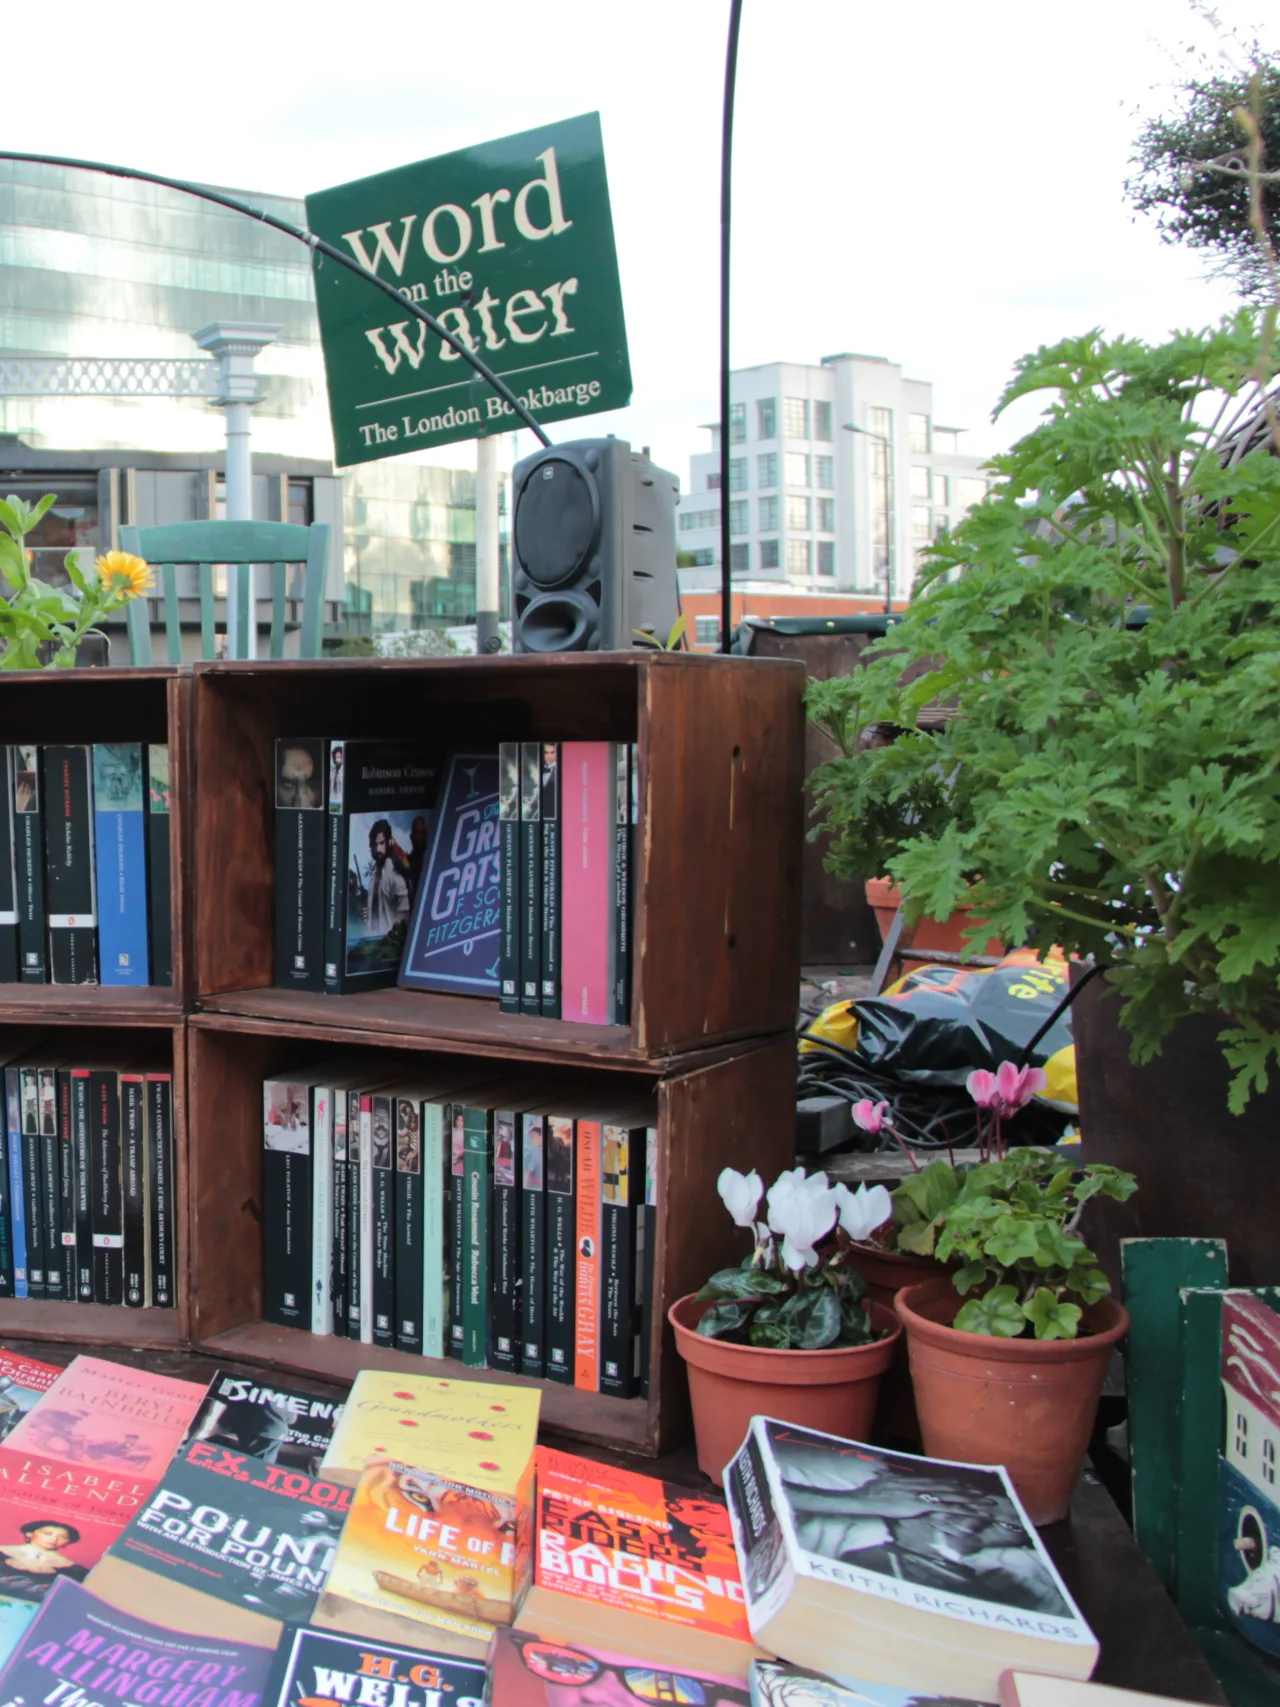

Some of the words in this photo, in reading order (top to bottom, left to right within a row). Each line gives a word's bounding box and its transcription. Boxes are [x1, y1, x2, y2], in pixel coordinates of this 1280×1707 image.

[341, 146, 574, 278] word
[397, 281, 429, 303] on
[432, 268, 474, 297] the
[365, 277, 580, 375] water
[360, 422, 398, 446] The
[403, 404, 481, 437] London
[485, 379, 602, 420] Bookbarge
[361, 765, 402, 780] Robinson
[403, 766, 436, 779] Crusoe
[426, 908, 500, 947] FITZGERA
[128, 1087, 136, 1107] MARK
[128, 1108, 136, 1130] TWAIN
[155, 1115, 164, 1155] CONNECTICUT
[78, 1120, 87, 1160] ADVENTURES
[129, 1145, 137, 1168] TRAMP
[79, 1170, 87, 1185] TOM
[129, 1168, 138, 1197] ABROAD
[156, 1156, 165, 1184] YANKEE
[471, 1171, 480, 1200] Cousin
[79, 1185, 88, 1211] SAWYER
[157, 1195, 165, 1212] KING
[471, 1201, 480, 1245] Rosamund
[158, 1242, 166, 1265] COURT
[471, 1249, 480, 1285] Rebecca
[471, 1285, 480, 1304] West
[577, 1304, 595, 1360] GRAY
[103, 1388, 178, 1414] BERYL
[287, 1429, 309, 1441] The
[21, 1460, 147, 1497] ISABEL
[541, 1486, 594, 1513] PETER
[596, 1502, 675, 1532] BISKIND
[541, 1495, 673, 1546] EASY
[744, 1474, 769, 1538] RICHARDS
[140, 1508, 213, 1547] FOR
[384, 1506, 463, 1552] LIFE
[466, 1537, 495, 1556] OF
[541, 1513, 704, 1573] RIDERS
[179, 1535, 252, 1571] INTRODUCTION
[539, 1528, 746, 1605] RAGING
[539, 1548, 706, 1612] BULLS
[809, 1559, 900, 1597] KEITH
[912, 1591, 1081, 1641] RICHARDS
[23, 1639, 265, 1707] ALLINGHAM
[64, 1628, 247, 1688] MARGERY
[356, 1651, 455, 1693] H.G.
